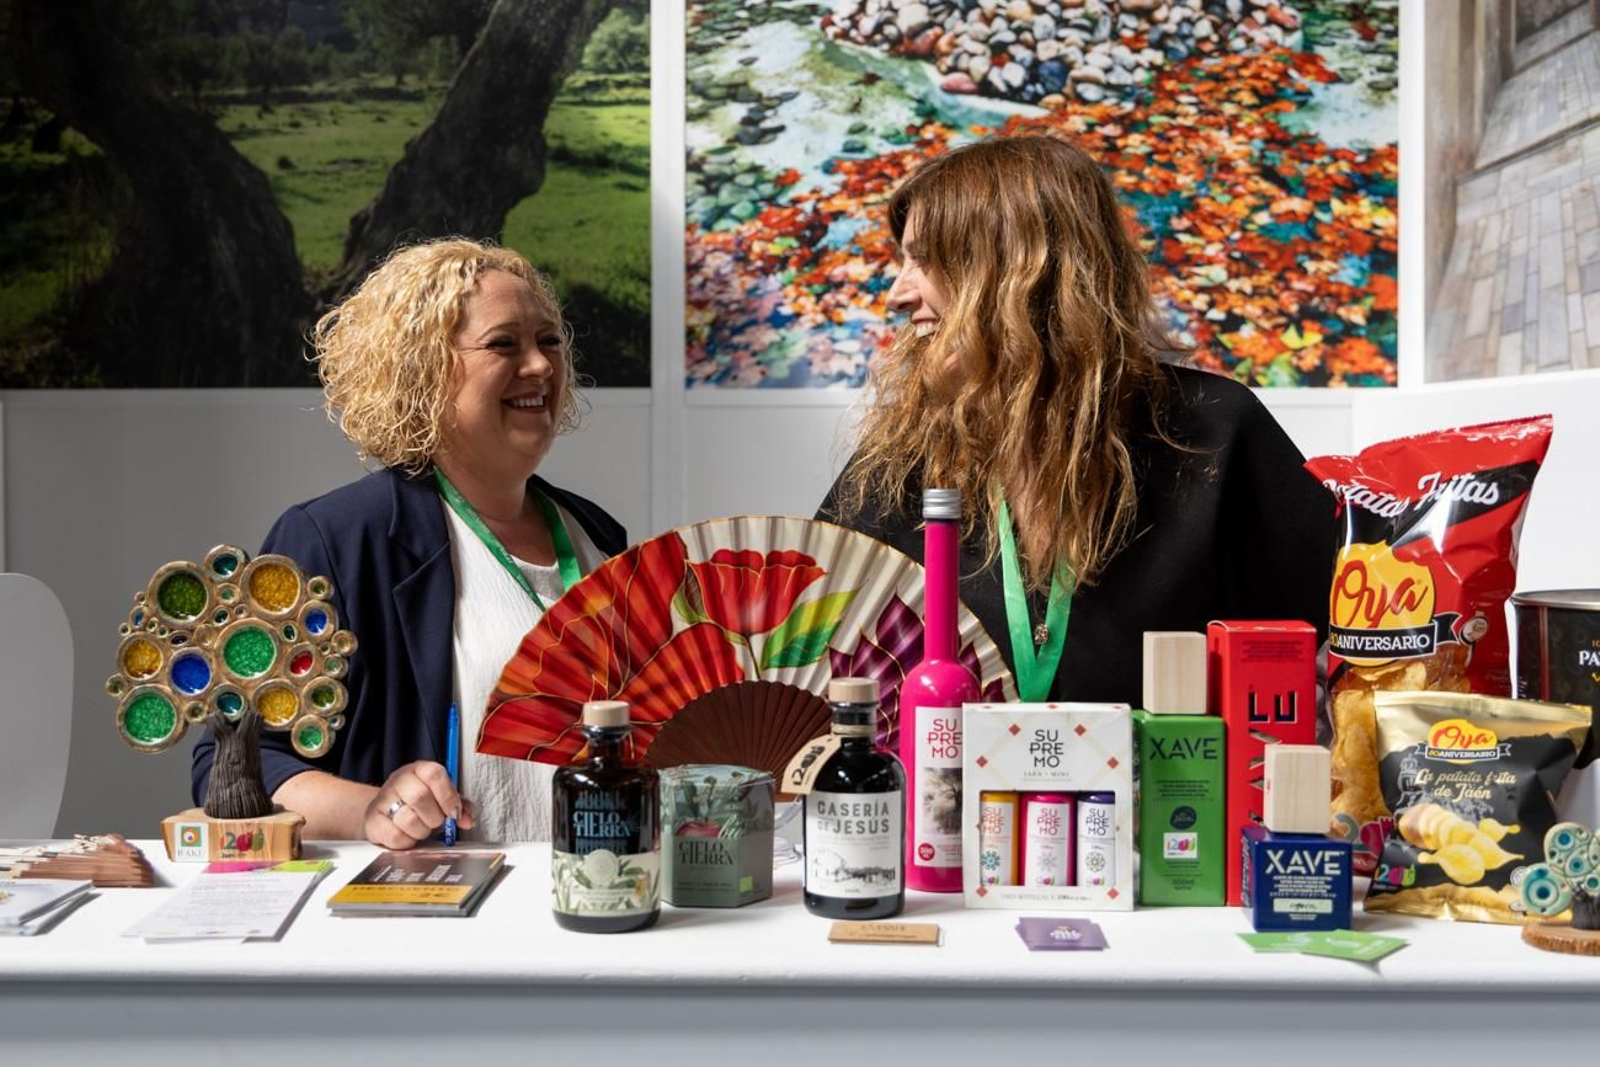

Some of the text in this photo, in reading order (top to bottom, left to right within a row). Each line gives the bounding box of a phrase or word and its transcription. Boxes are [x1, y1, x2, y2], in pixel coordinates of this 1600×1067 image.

[1333, 560, 1429, 628] Oya
[933, 718, 957, 732] SU
[928, 731, 962, 745] PRE
[1034, 729, 1059, 742] SU
[1433, 726, 1494, 749] Oya
[931, 745, 959, 759] MO
[1029, 742, 1064, 755] PRE
[1149, 737, 1219, 760] XAVE
[1034, 755, 1060, 768] MO
[1414, 768, 1434, 785] La
[1435, 770, 1482, 786] patata
[1433, 783, 1491, 803] de Jaén
[817, 799, 889, 817] CASERÍA
[984, 807, 1002, 816] SU
[1041, 808, 1058, 817] SU
[1089, 808, 1106, 818] SU
[573, 811, 621, 824] CIELO
[982, 816, 1005, 825] PRE
[1037, 817, 1060, 827] PRE
[1085, 817, 1109, 827] PRE
[573, 821, 631, 837] TIERRA
[832, 817, 889, 834] JESÚS
[983, 825, 1002, 834] MO
[1039, 826, 1058, 836] MO
[1088, 826, 1106, 836] MO
[679, 841, 723, 852] CIELO
[679, 851, 733, 865] TIERRA
[1265, 849, 1341, 875] XAVE
